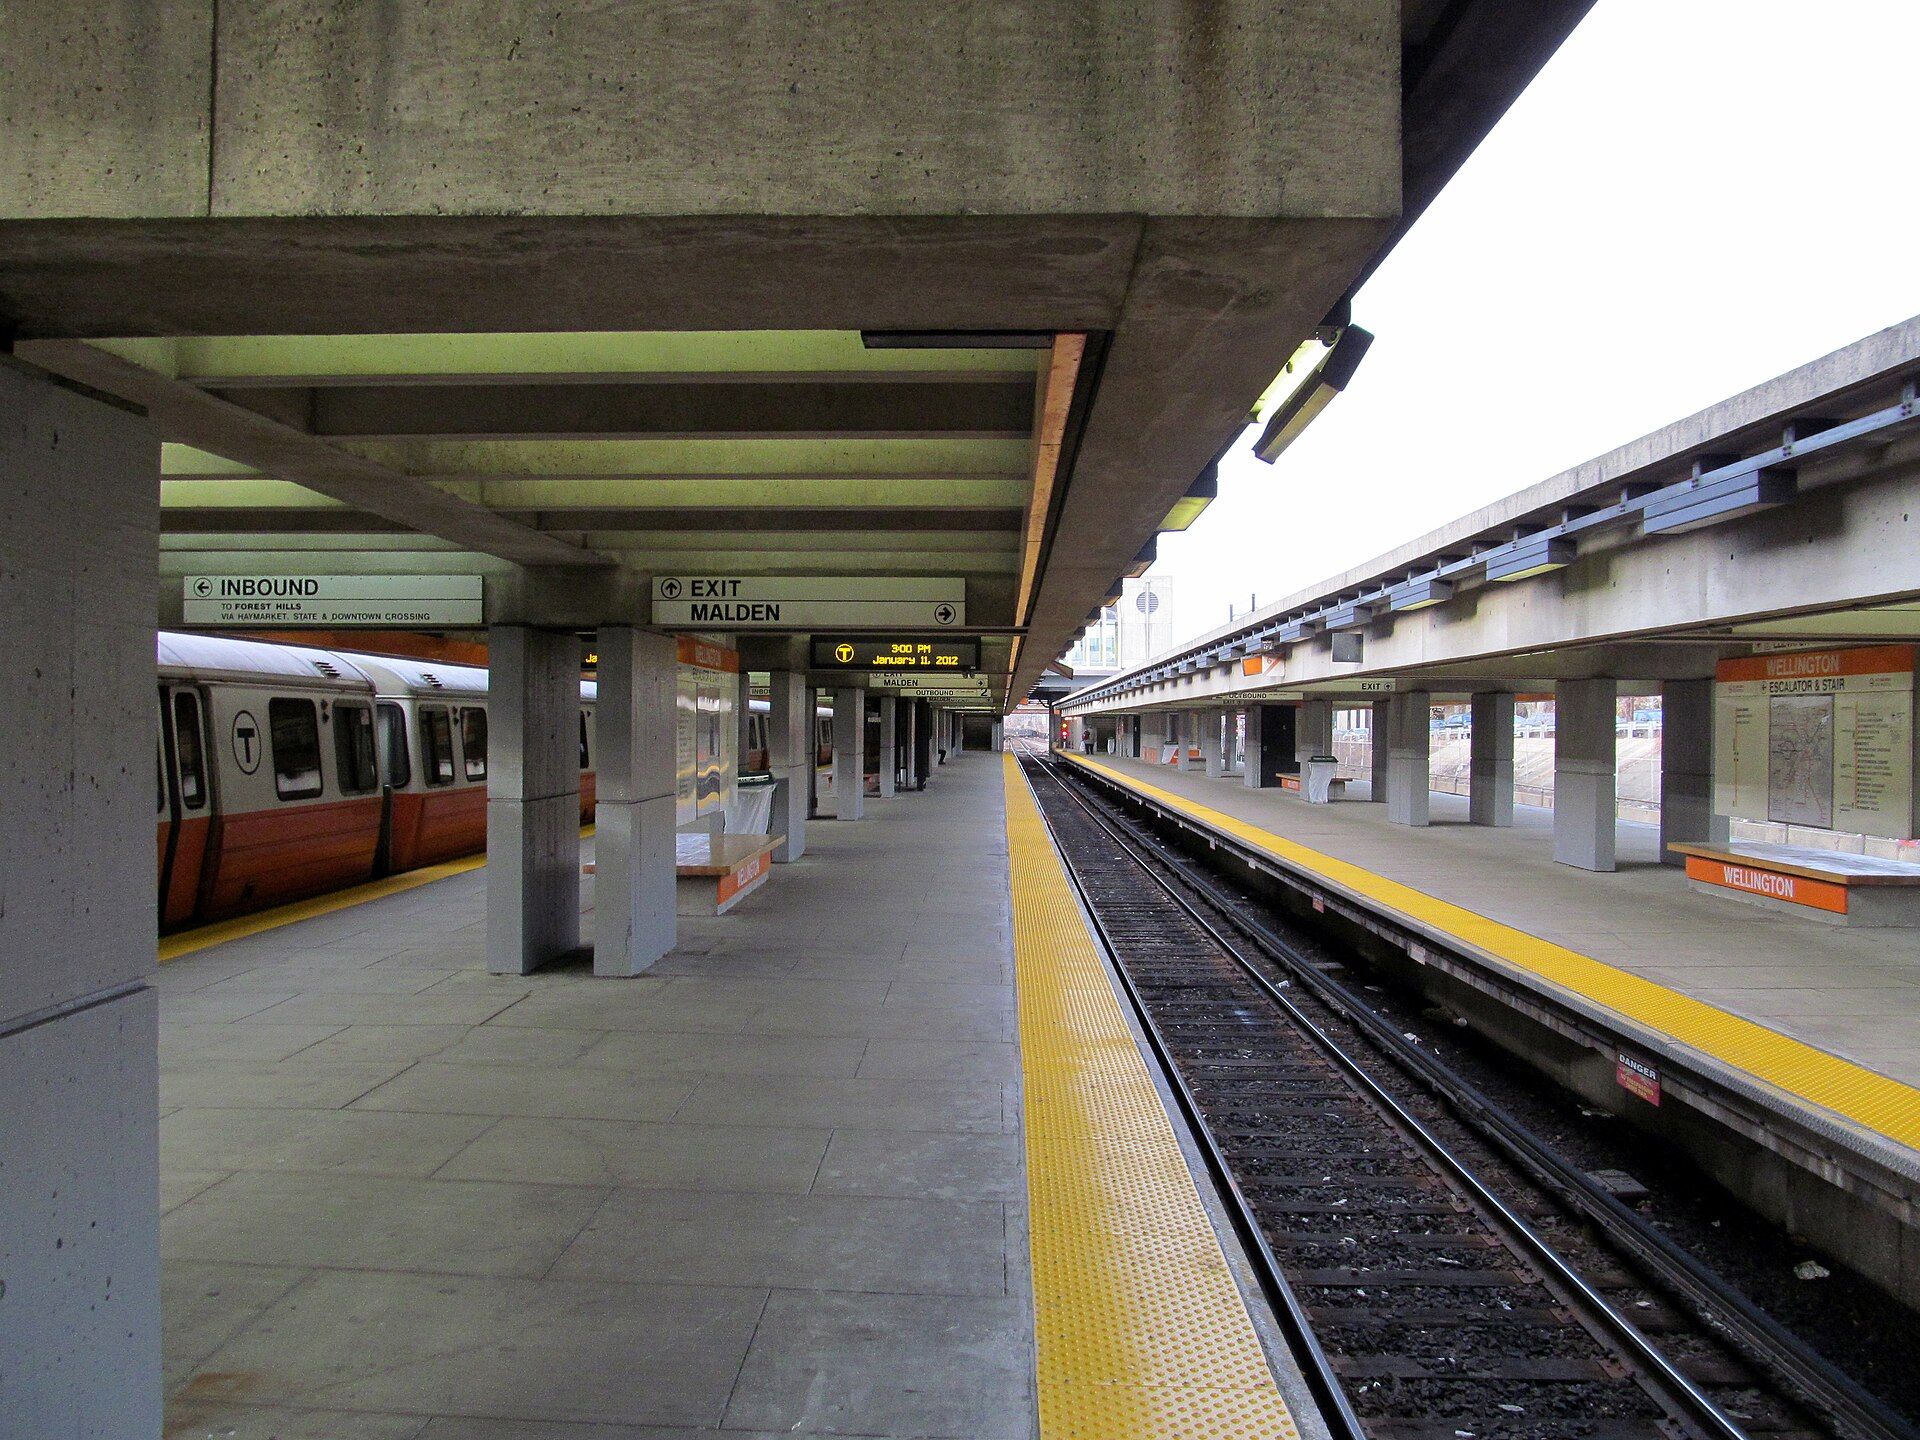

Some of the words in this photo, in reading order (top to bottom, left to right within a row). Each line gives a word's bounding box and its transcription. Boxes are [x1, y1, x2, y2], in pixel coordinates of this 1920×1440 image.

[221, 579, 319, 596] INBOUND
[691, 579, 742, 597] EXIT
[221, 603, 232, 611] TO
[235, 603, 272, 611] FOREST
[275, 603, 302, 611] HILLS
[691, 603, 780, 621] MALDEN
[221, 612, 235, 621] VIA
[293, 612, 318, 621] STATE
[321, 612, 328, 621] &
[331, 612, 382, 621] DOWNTOWN
[384, 612, 431, 621] CROSSING
[891, 644, 913, 654] 3:00
[917, 644, 931, 654] PM
[872, 655, 916, 666] January
[935, 655, 959, 666] 2012
[1766, 654, 1840, 676] WELLINGTON
[883, 679, 918, 687] MALDEN
[1361, 682, 1381, 691] EXIT
[1769, 679, 1812, 693] ESCALATOR
[1815, 679, 1821, 691] &
[1823, 678, 1845, 691] STAIR
[915, 689, 954, 697] OUTBOUND
[1723, 865, 1794, 898] WELLINGTON
[1619, 1053, 1656, 1080] DANGER
